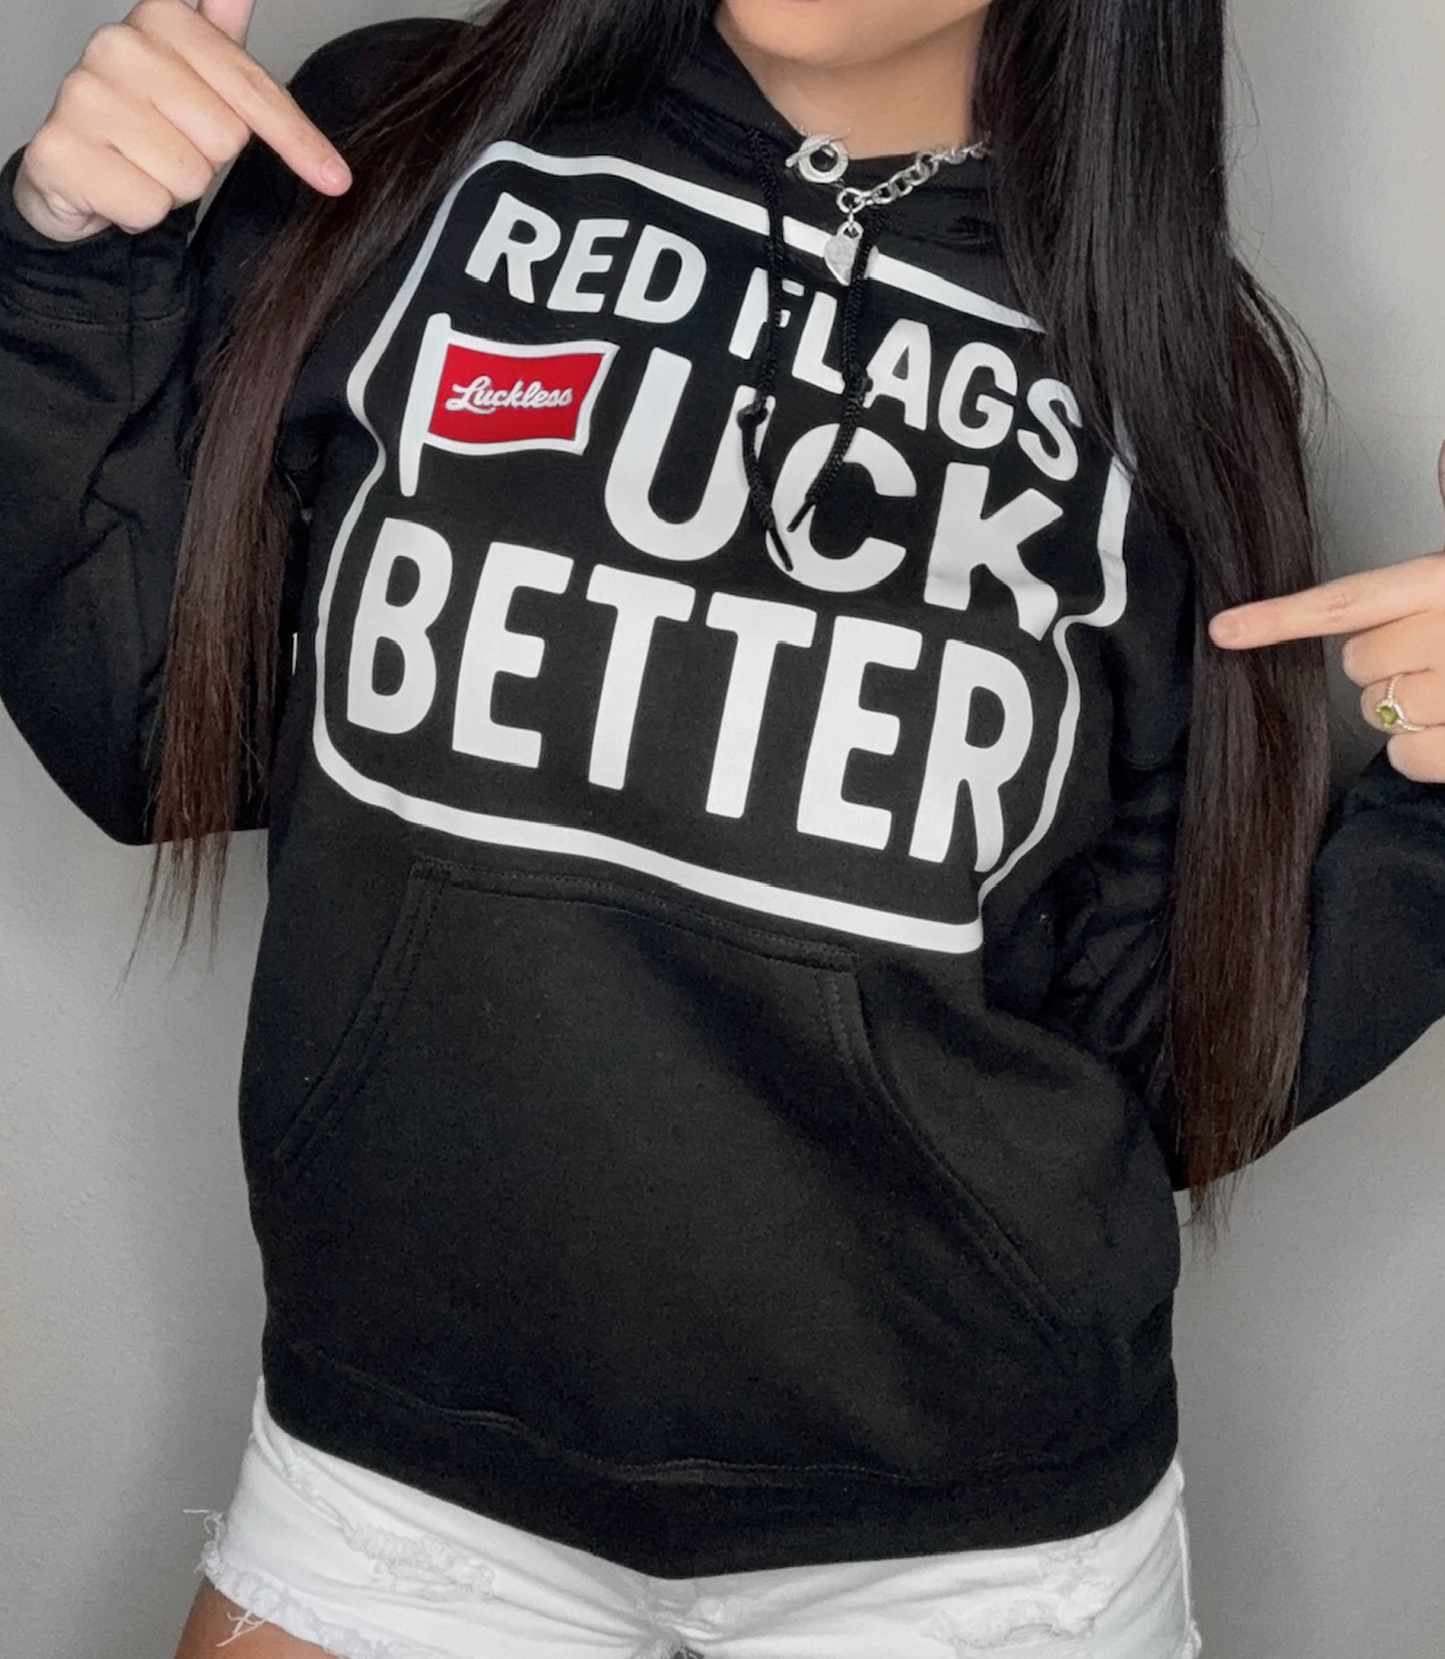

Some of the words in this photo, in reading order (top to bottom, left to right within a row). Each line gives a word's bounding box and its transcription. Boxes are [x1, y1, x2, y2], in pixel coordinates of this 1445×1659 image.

[445, 375, 573, 415] Luckless
[465, 192, 707, 324] RED
[728, 267, 1082, 482] FLAGS
[347, 518, 1034, 873] BETTER
